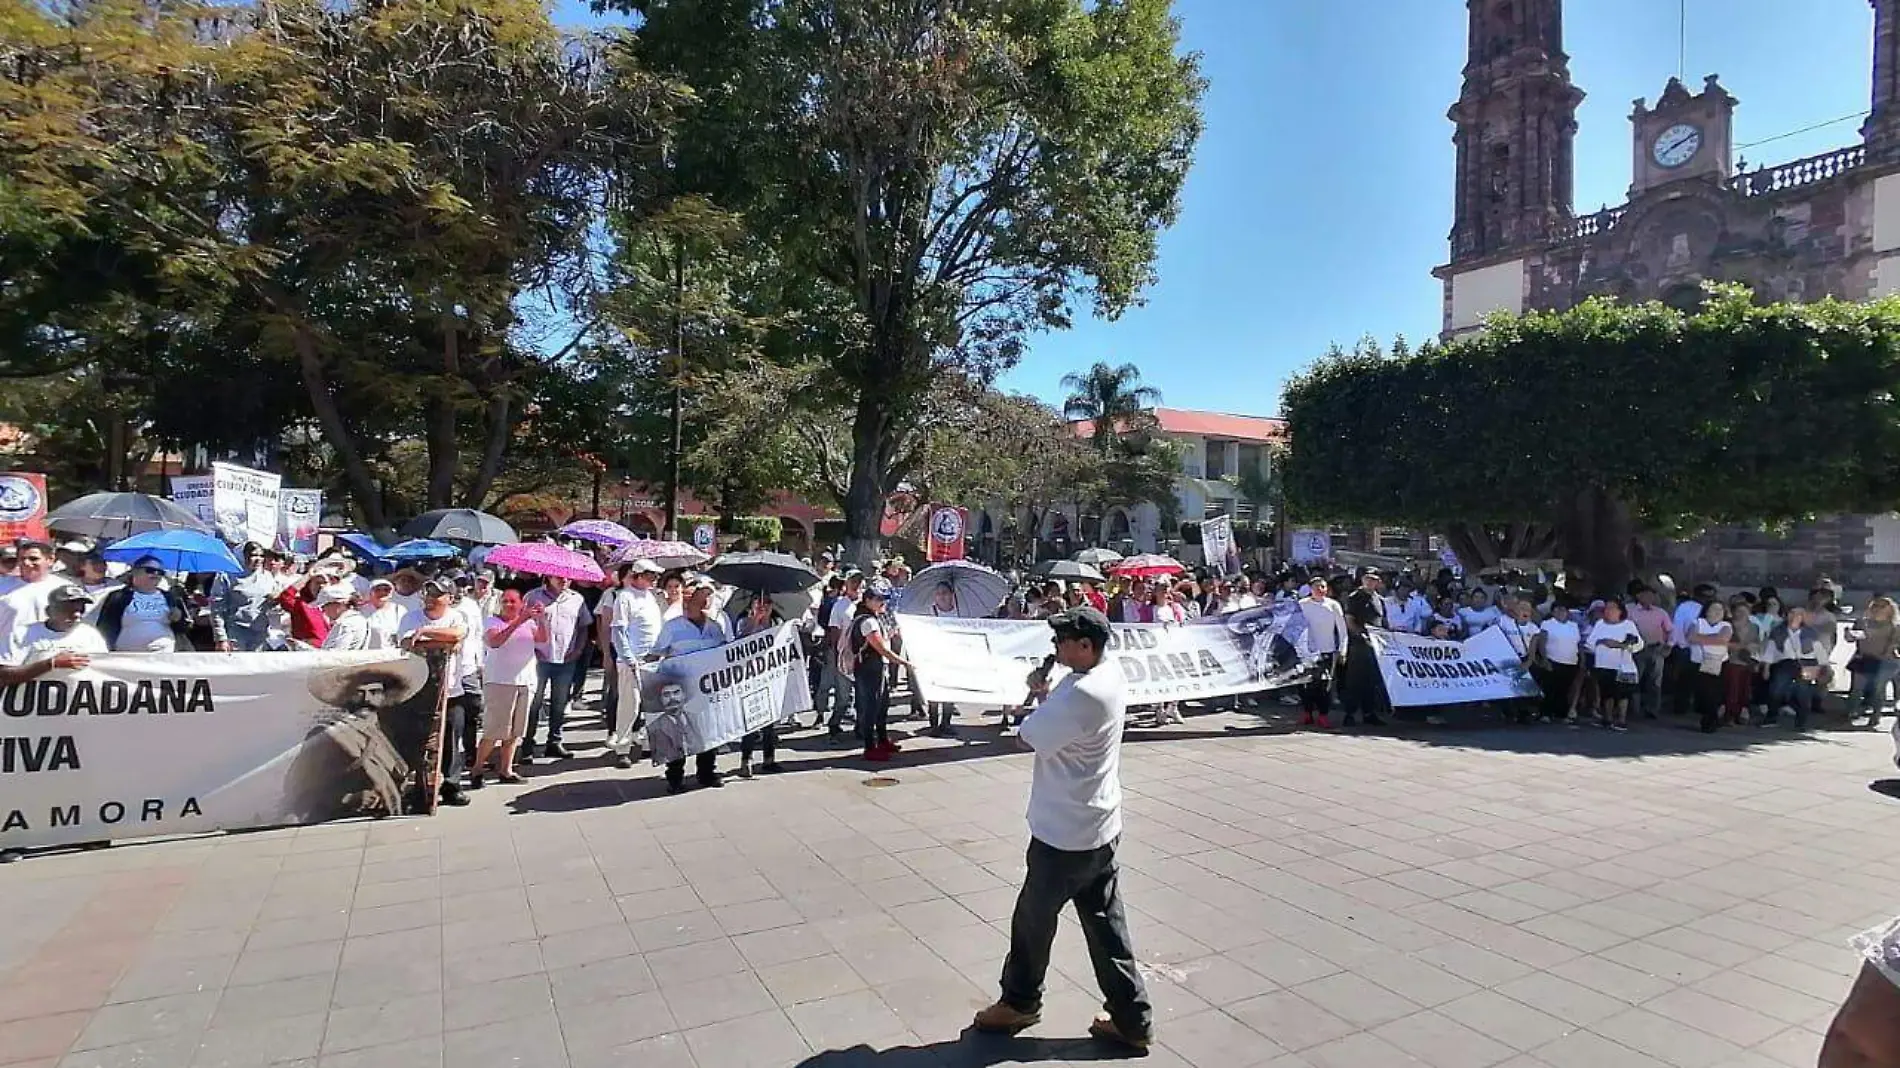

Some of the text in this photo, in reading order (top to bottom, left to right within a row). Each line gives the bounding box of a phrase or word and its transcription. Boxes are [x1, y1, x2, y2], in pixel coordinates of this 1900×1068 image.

[175, 489, 214, 499] CIUDADA
[726, 635, 774, 663] UNIDAD
[1107, 629, 1158, 650] DAD
[1409, 646, 1460, 660] UNIDAD
[699, 644, 800, 694] CIUDADANA
[1396, 658, 1500, 678] CIUDADANA
[0, 679, 214, 717] UDADANA
[0, 735, 81, 773] IVA
